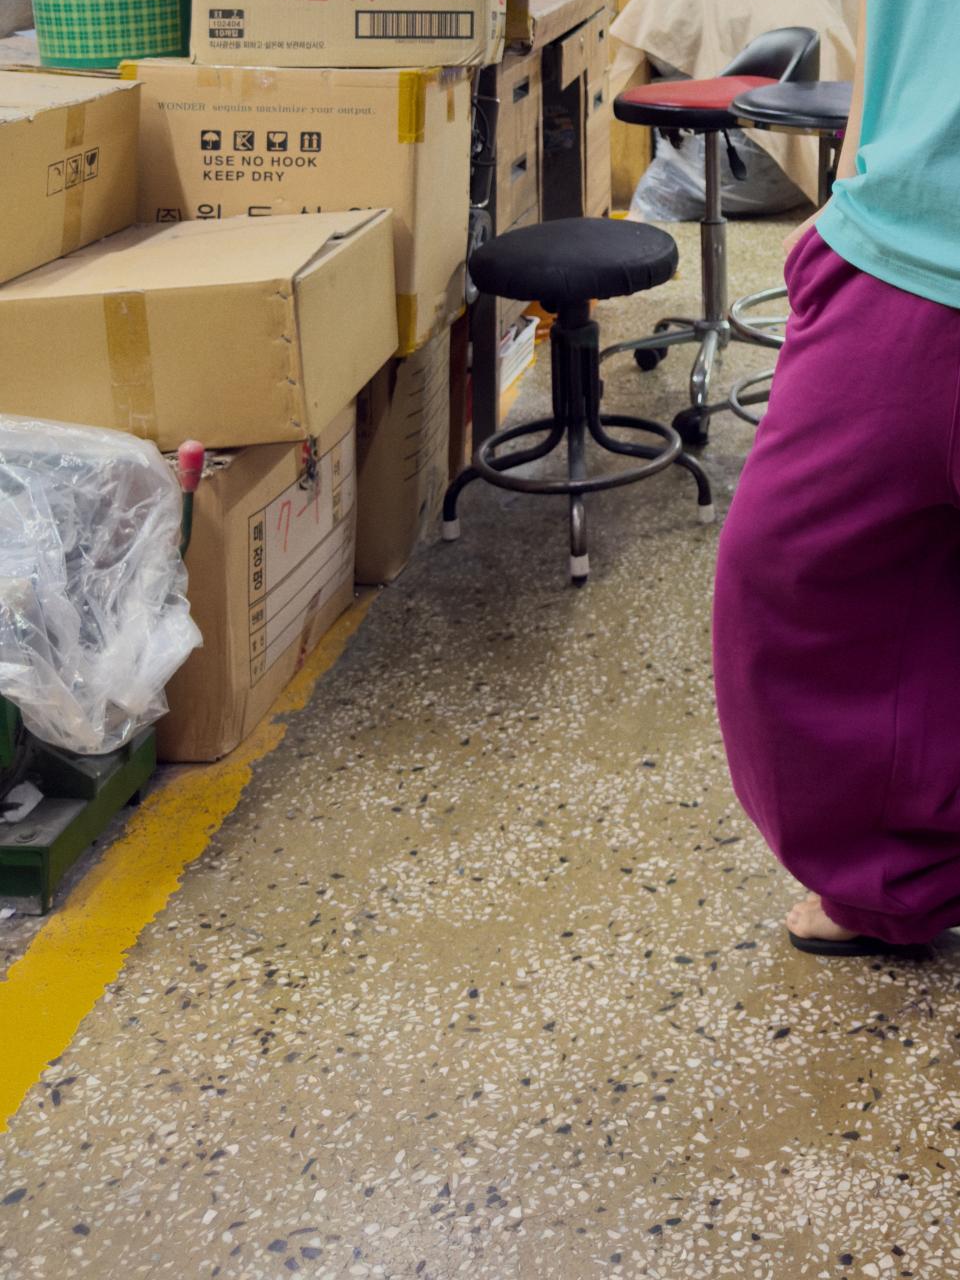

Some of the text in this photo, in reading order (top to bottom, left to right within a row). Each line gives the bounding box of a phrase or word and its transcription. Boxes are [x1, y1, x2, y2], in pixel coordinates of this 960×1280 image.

[157, 101, 206, 112] WONDER
[310, 105, 334, 115] your
[203, 155, 318, 168] USE NO HOOK
[203, 170, 285, 183] KEEP DRY
